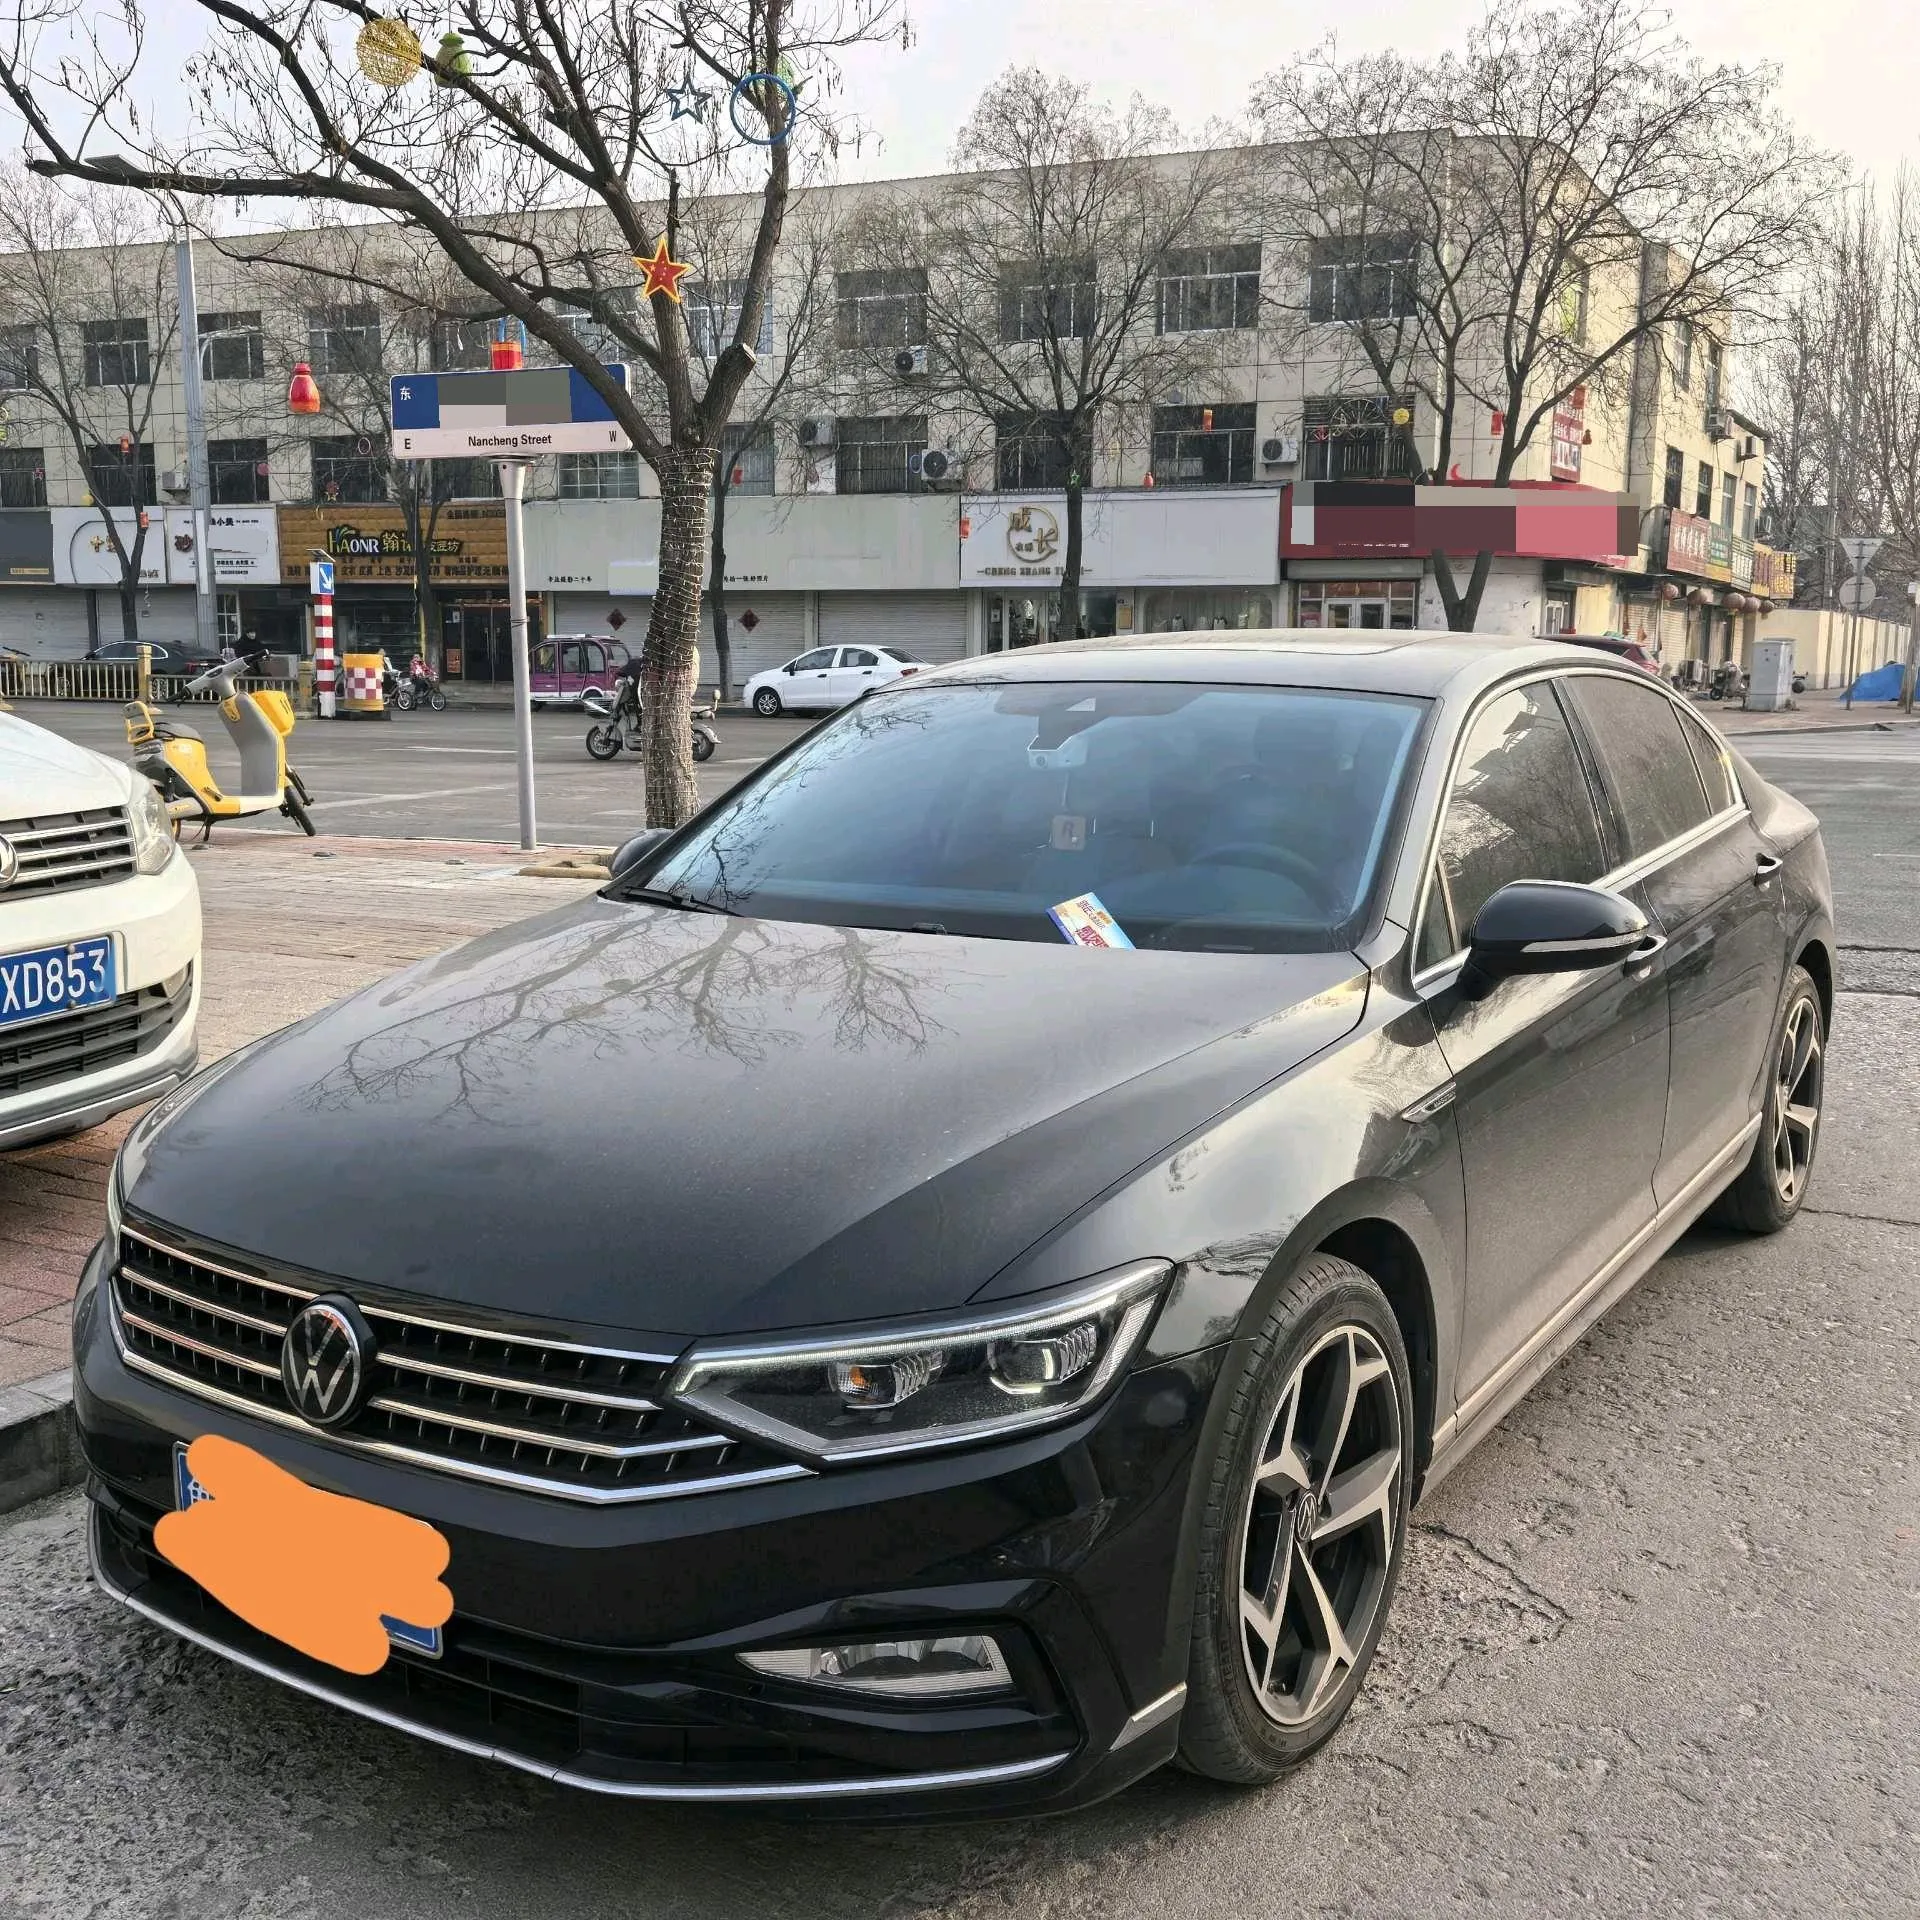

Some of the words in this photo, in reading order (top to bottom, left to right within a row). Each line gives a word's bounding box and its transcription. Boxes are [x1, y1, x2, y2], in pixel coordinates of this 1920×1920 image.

[400, 386, 412, 401] 东
[404, 438, 411, 450] E
[468, 435, 518, 448] Nancheng
[521, 434, 552, 446] Street
[609, 430, 617, 443] W
[0, 948, 106, 1015] XD853
